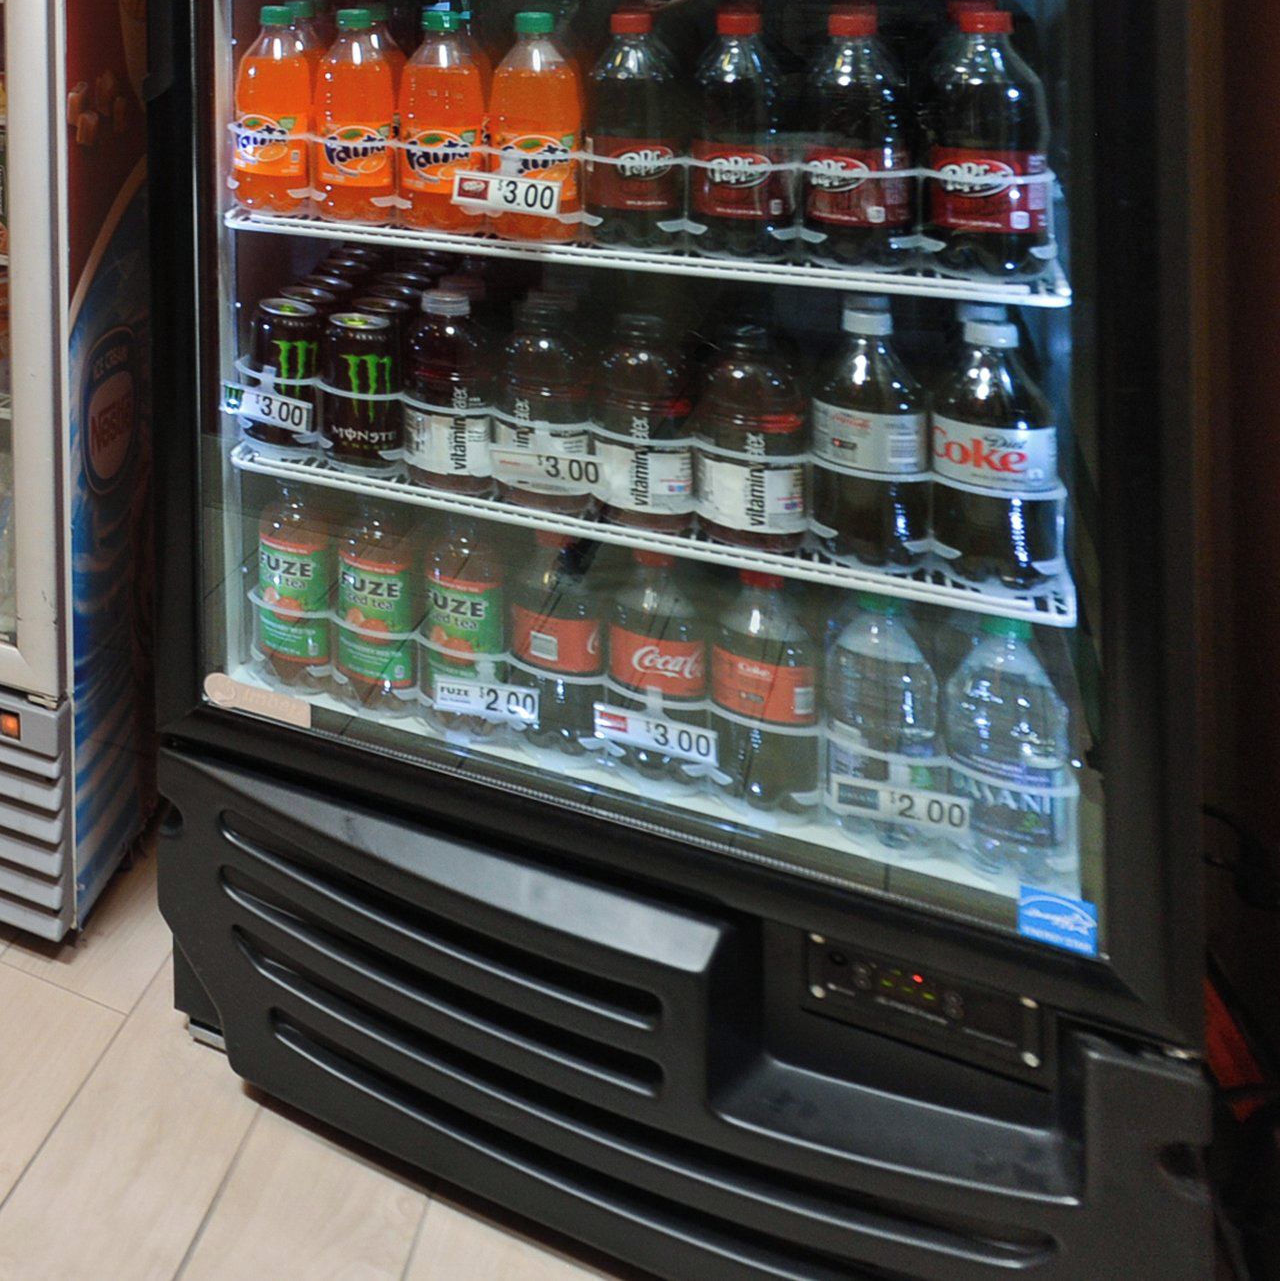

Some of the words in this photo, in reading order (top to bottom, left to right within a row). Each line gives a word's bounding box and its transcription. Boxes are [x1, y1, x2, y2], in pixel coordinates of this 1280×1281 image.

[324, 134, 388, 166] Fanta
[406, 138, 472, 170] Fanta
[497, 181, 555, 211] $3.00
[259, 553, 313, 579] FUZE
[342, 572, 401, 599] FUZE
[371, 597, 394, 611] tea
[440, 686, 470, 697] FUZE
[479, 685, 537, 716] $2.00
[645, 722, 711, 757] $3.00
[890, 791, 966, 829] $2.00
